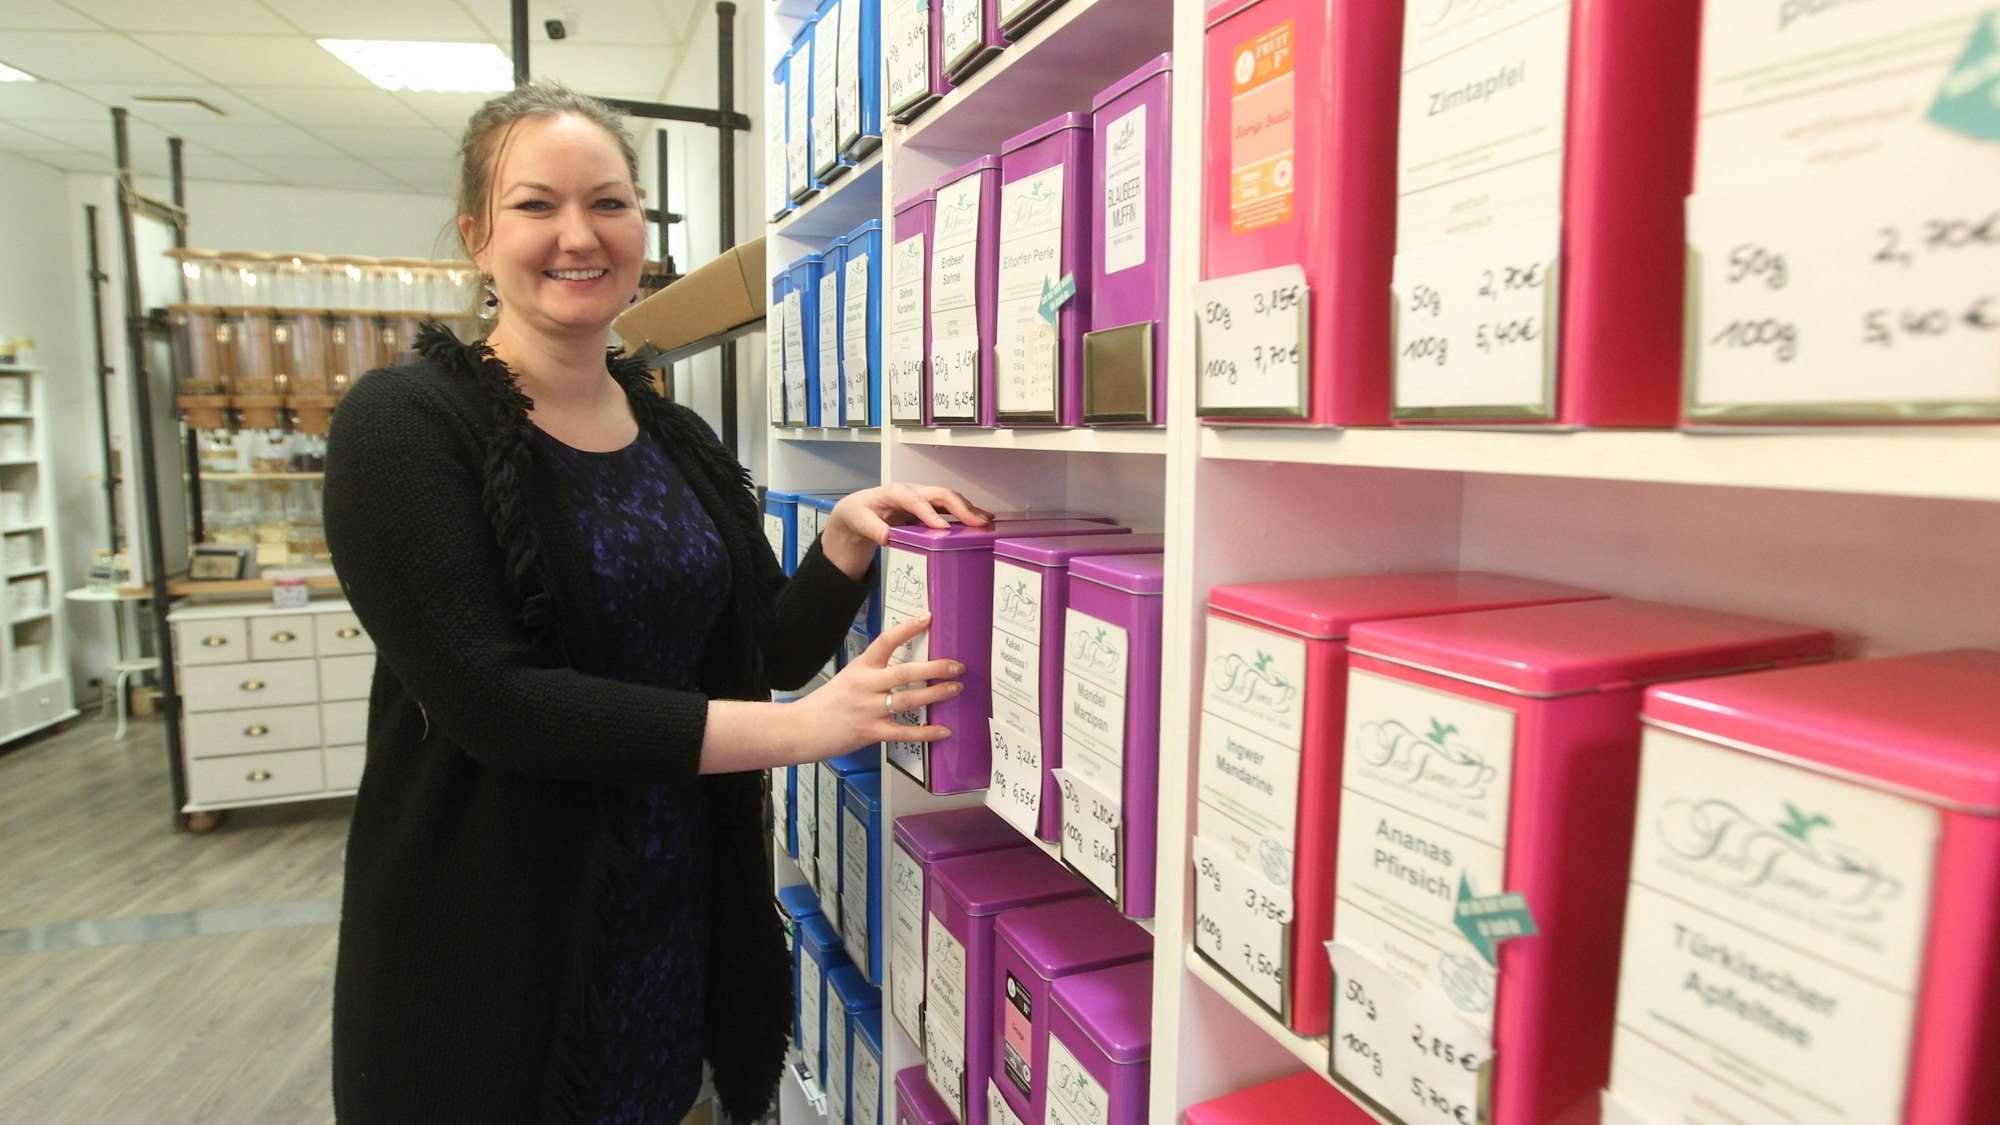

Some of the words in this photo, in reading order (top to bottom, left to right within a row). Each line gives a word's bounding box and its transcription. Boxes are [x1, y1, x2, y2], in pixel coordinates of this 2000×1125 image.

[1427, 59, 1526, 117] Zimtapfel
[1108, 176, 1141, 208] BLAUBEER
[1112, 203, 1136, 228] MUFFIN
[941, 254, 965, 269] Erdbeer
[1003, 252, 1032, 269] Eitorfer
[1033, 246, 1055, 262] Perle
[1727, 242, 1788, 290] 50g
[1872, 212, 2000, 267] 2,70€
[900, 287, 913, 299] Sahne
[943, 272, 961, 285] Sahne
[1411, 284, 1440, 317] 50g
[1479, 262, 1544, 301] 2,70€
[1207, 300, 1231, 330] 50g
[1254, 285, 1299, 317] 3,85€
[1403, 336, 1448, 366] 100g
[1477, 316, 1542, 353] 5,40€
[1711, 318, 1799, 362] 100g
[935, 356, 949, 381] 50g
[1205, 360, 1237, 385] 100g
[1254, 342, 1299, 375] 7,70€
[903, 391, 919, 408] 5,22€
[933, 392, 949, 409] 100g
[955, 391, 975, 410] 6,25€
[1000, 649, 1025, 670] Haselnuss
[1005, 636, 1021, 652] Kakao
[1004, 665, 1023, 683] Nougat
[1078, 682, 1106, 709] Mandel
[1073, 701, 1109, 733] Marzipan
[994, 731, 1009, 760] 50g
[1226, 735, 1264, 766] Ingwer
[993, 769, 1007, 798] 100g
[1013, 782, 1037, 812] 6,55€
[1216, 754, 1274, 796] Mandarine
[1064, 779, 1080, 814] 50g
[1092, 799, 1116, 830] 2,80€
[1063, 821, 1083, 853] 100g
[1093, 840, 1117, 869] 5,60€
[1376, 818, 1453, 866] Ananas
[1201, 857, 1221, 892] 50g
[1244, 888, 1289, 926] 3,75€
[1373, 848, 1452, 900] Pfirsich
[1197, 913, 1222, 951] 100g
[1243, 943, 1283, 986] 7,50€
[1672, 921, 1840, 1018] Türkischer
[1345, 978, 1377, 1021] 50g
[1684, 971, 1812, 1049] Apfeltee
[1342, 1032, 1383, 1078] 100g
